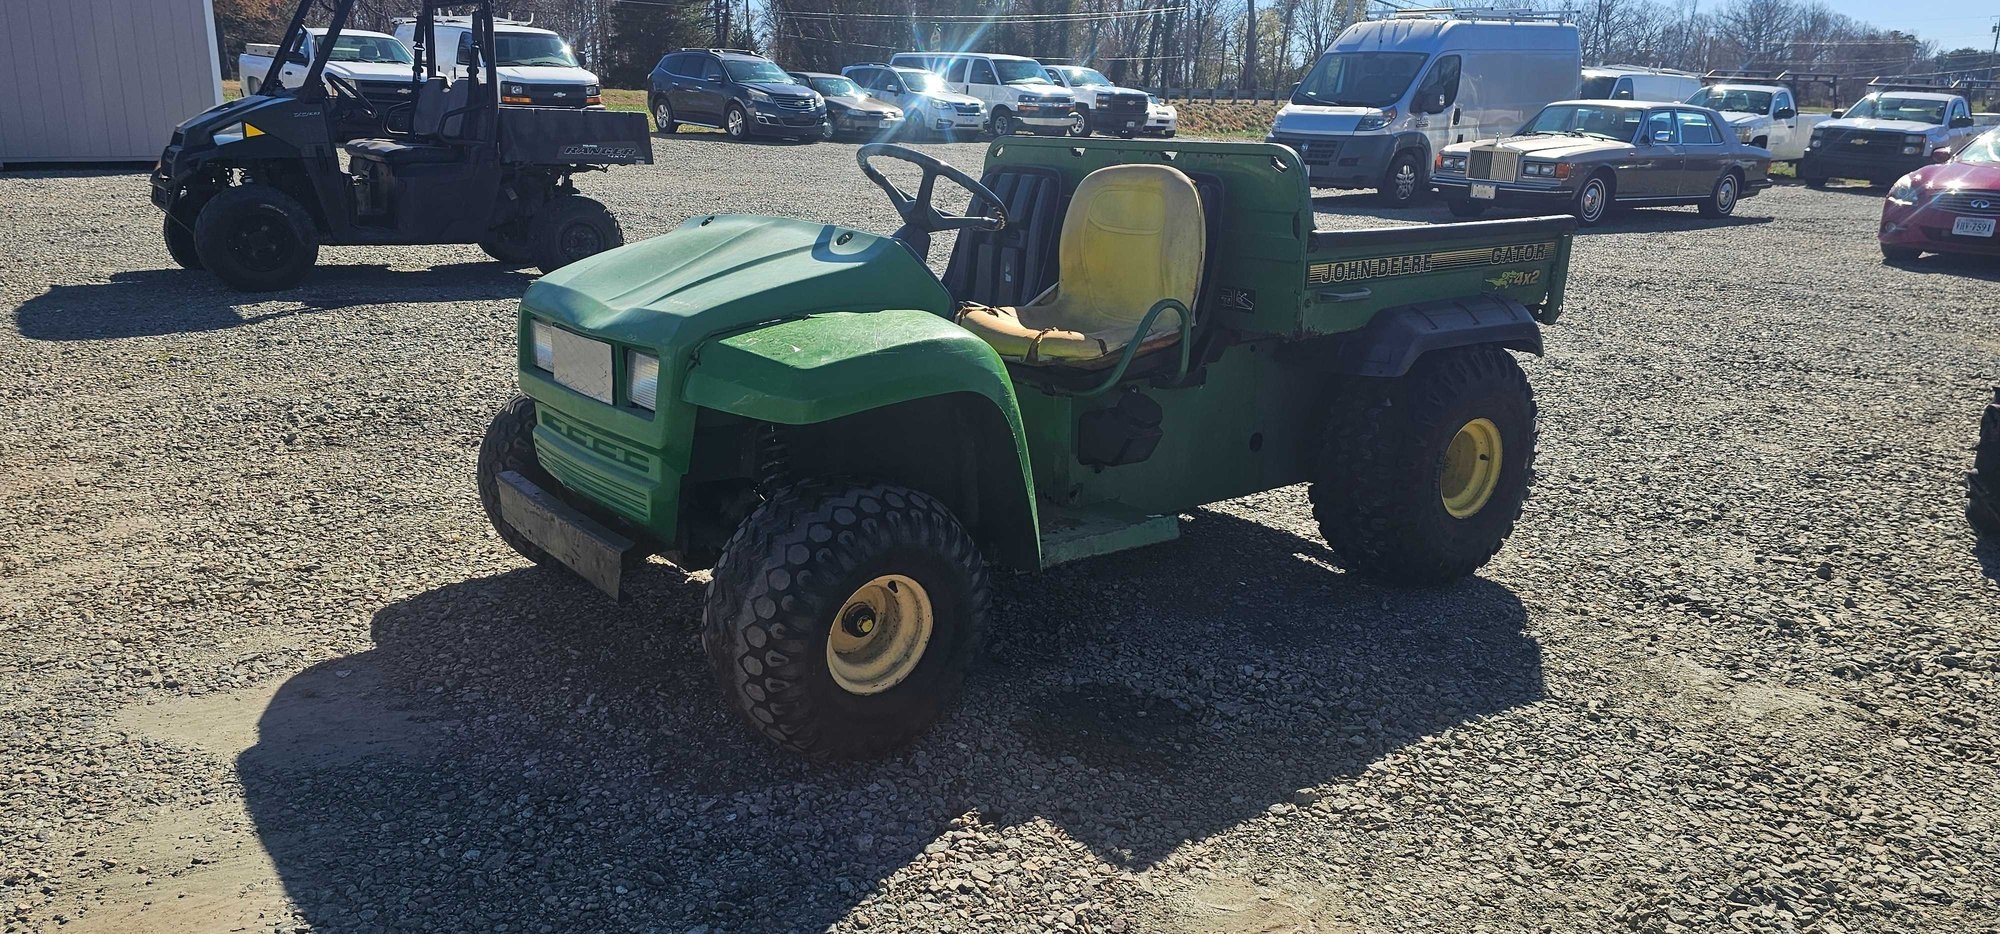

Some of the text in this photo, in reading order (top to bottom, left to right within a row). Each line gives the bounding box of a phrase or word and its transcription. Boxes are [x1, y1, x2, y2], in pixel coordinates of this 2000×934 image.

[1320, 244, 1546, 283] JOHN DEERE GATOR
